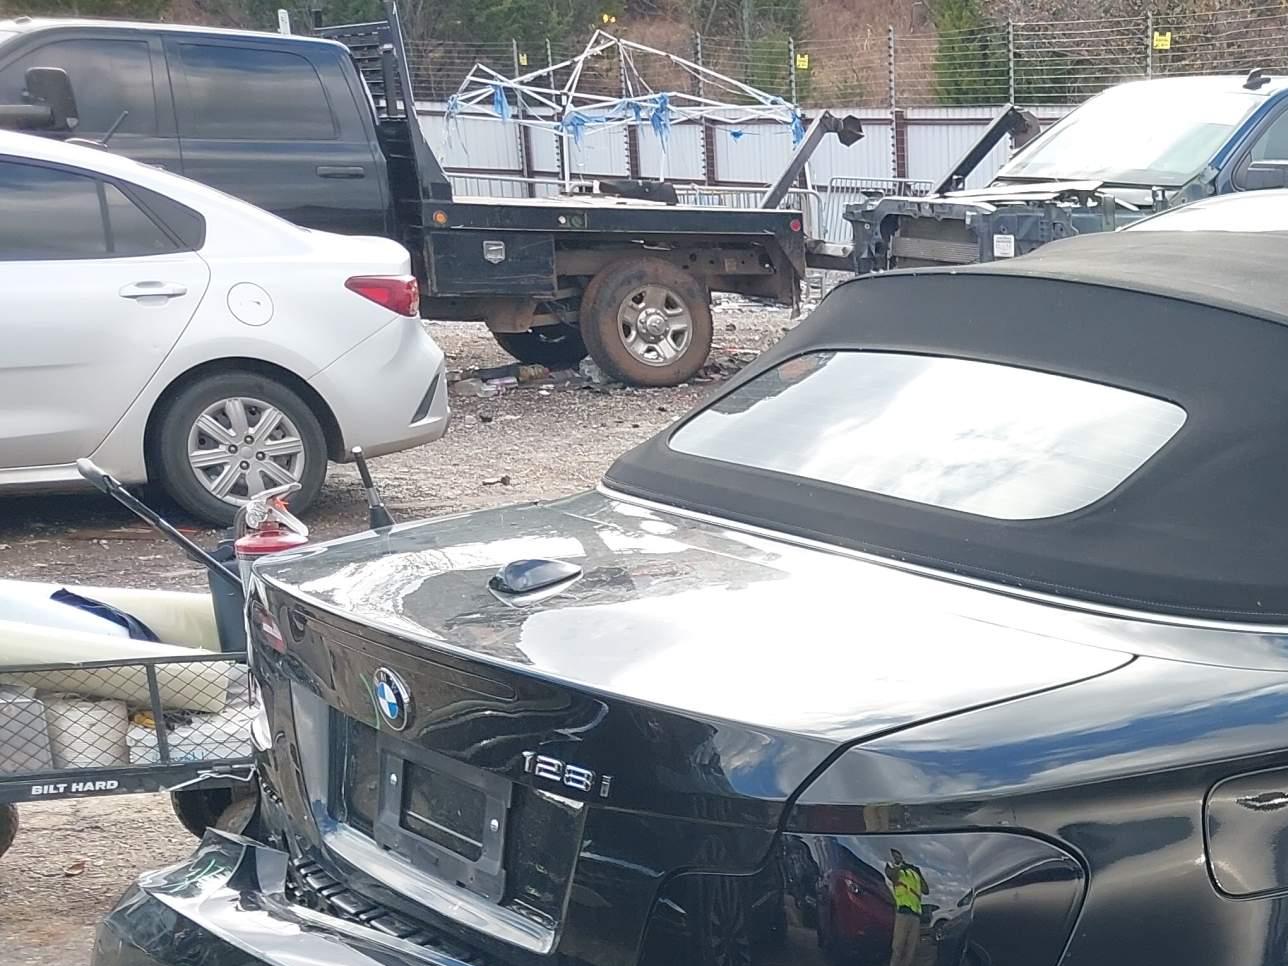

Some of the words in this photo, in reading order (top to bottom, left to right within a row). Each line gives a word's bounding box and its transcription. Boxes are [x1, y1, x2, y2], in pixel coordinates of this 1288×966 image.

[31, 784, 68, 795] BILT
[71, 780, 119, 792] HARD
[522, 751, 613, 797] 128i
